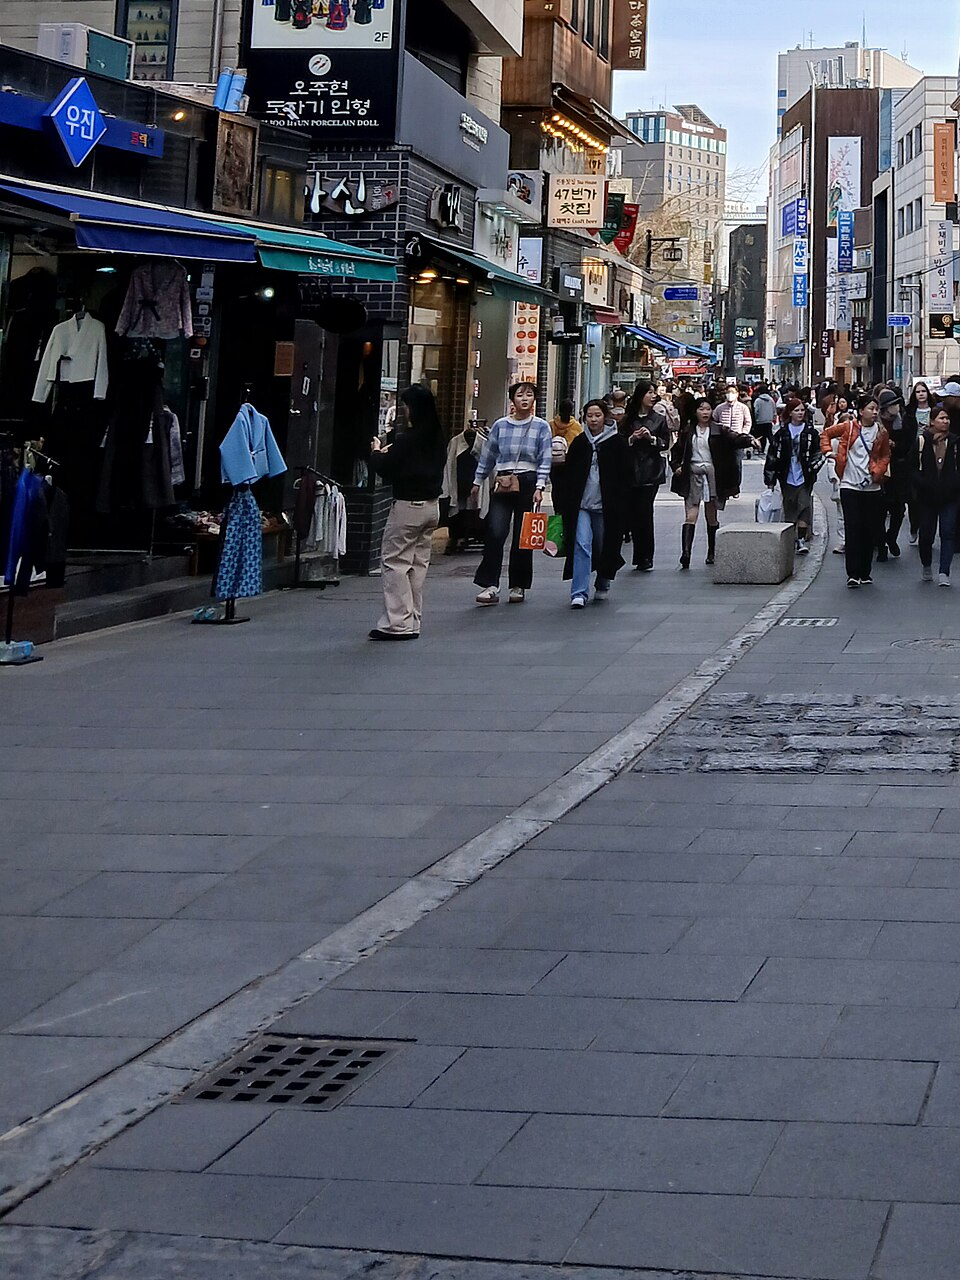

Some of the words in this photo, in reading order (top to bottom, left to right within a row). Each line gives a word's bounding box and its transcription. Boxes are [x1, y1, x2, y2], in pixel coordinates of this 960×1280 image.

[374, 32, 390, 42] 2F
[289, 80, 348, 96] 오주현
[265, 100, 324, 115] 도자기
[331, 99, 371, 116] 인형
[65, 105, 95, 140] 우진
[311, 119, 356, 127] PORCELAIN
[357, 119, 380, 127] DOLL
[554, 187, 597, 201] 47번가
[559, 202, 591, 215] 찻집
[531, 519, 545, 534] 50
